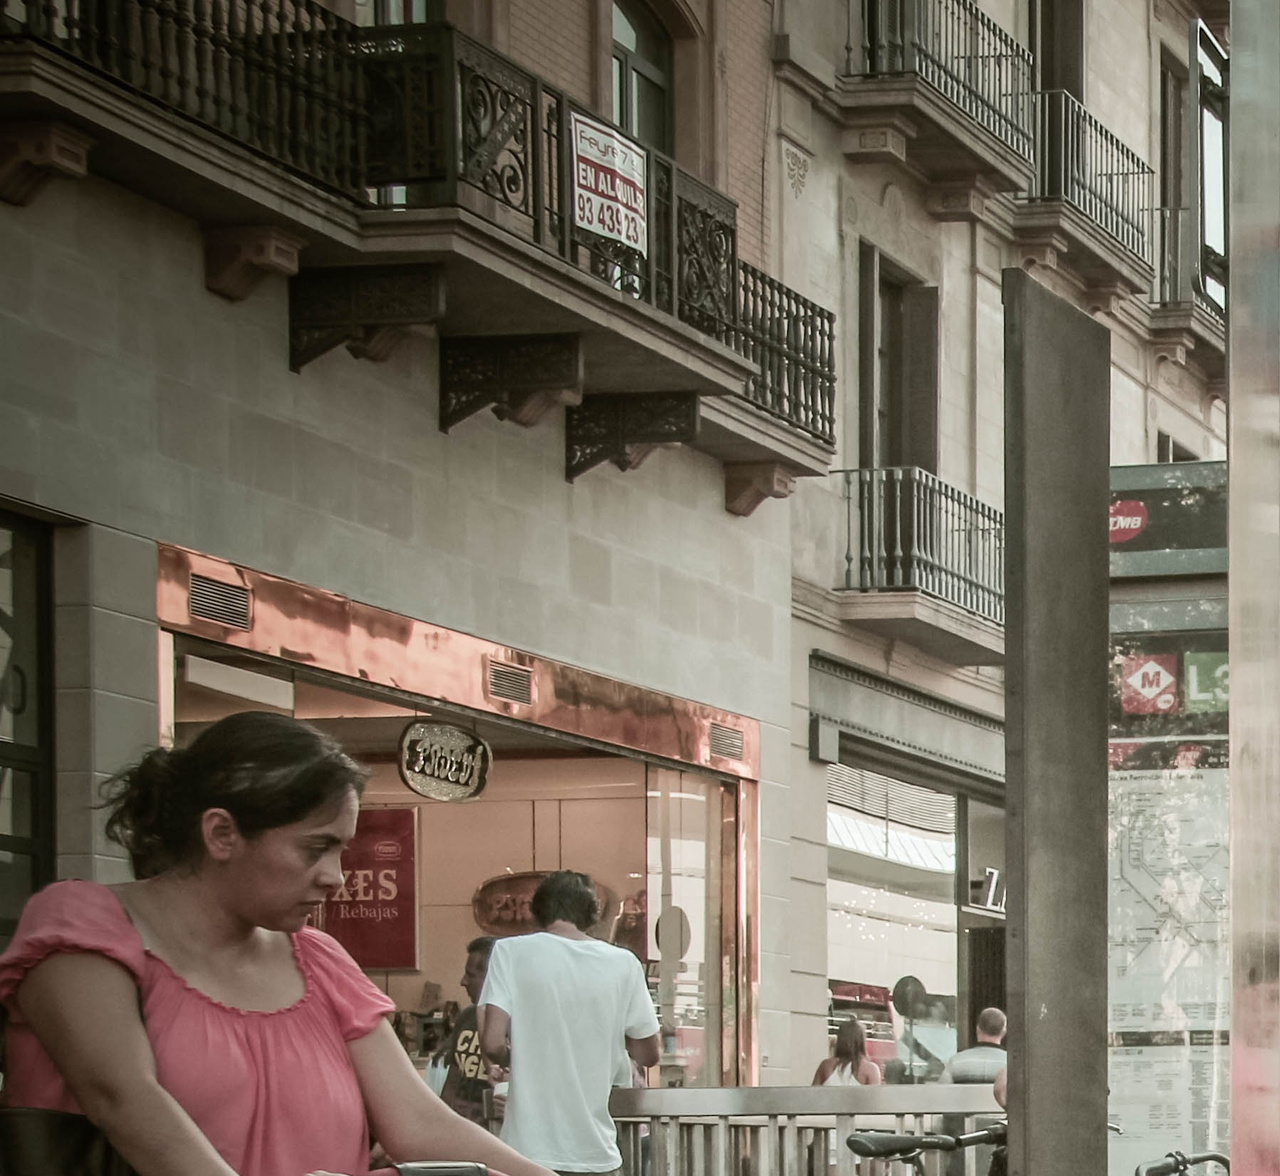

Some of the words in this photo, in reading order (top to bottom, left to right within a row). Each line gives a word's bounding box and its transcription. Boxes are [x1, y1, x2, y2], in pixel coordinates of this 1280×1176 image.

[578, 161, 596, 190] EN
[578, 193, 594, 226] 93
[597, 202, 623, 236] 439
[624, 213, 639, 245] 23
[1141, 670, 1161, 689] M
[332, 869, 398, 902] XES
[340, 903, 399, 922] Rebajas
